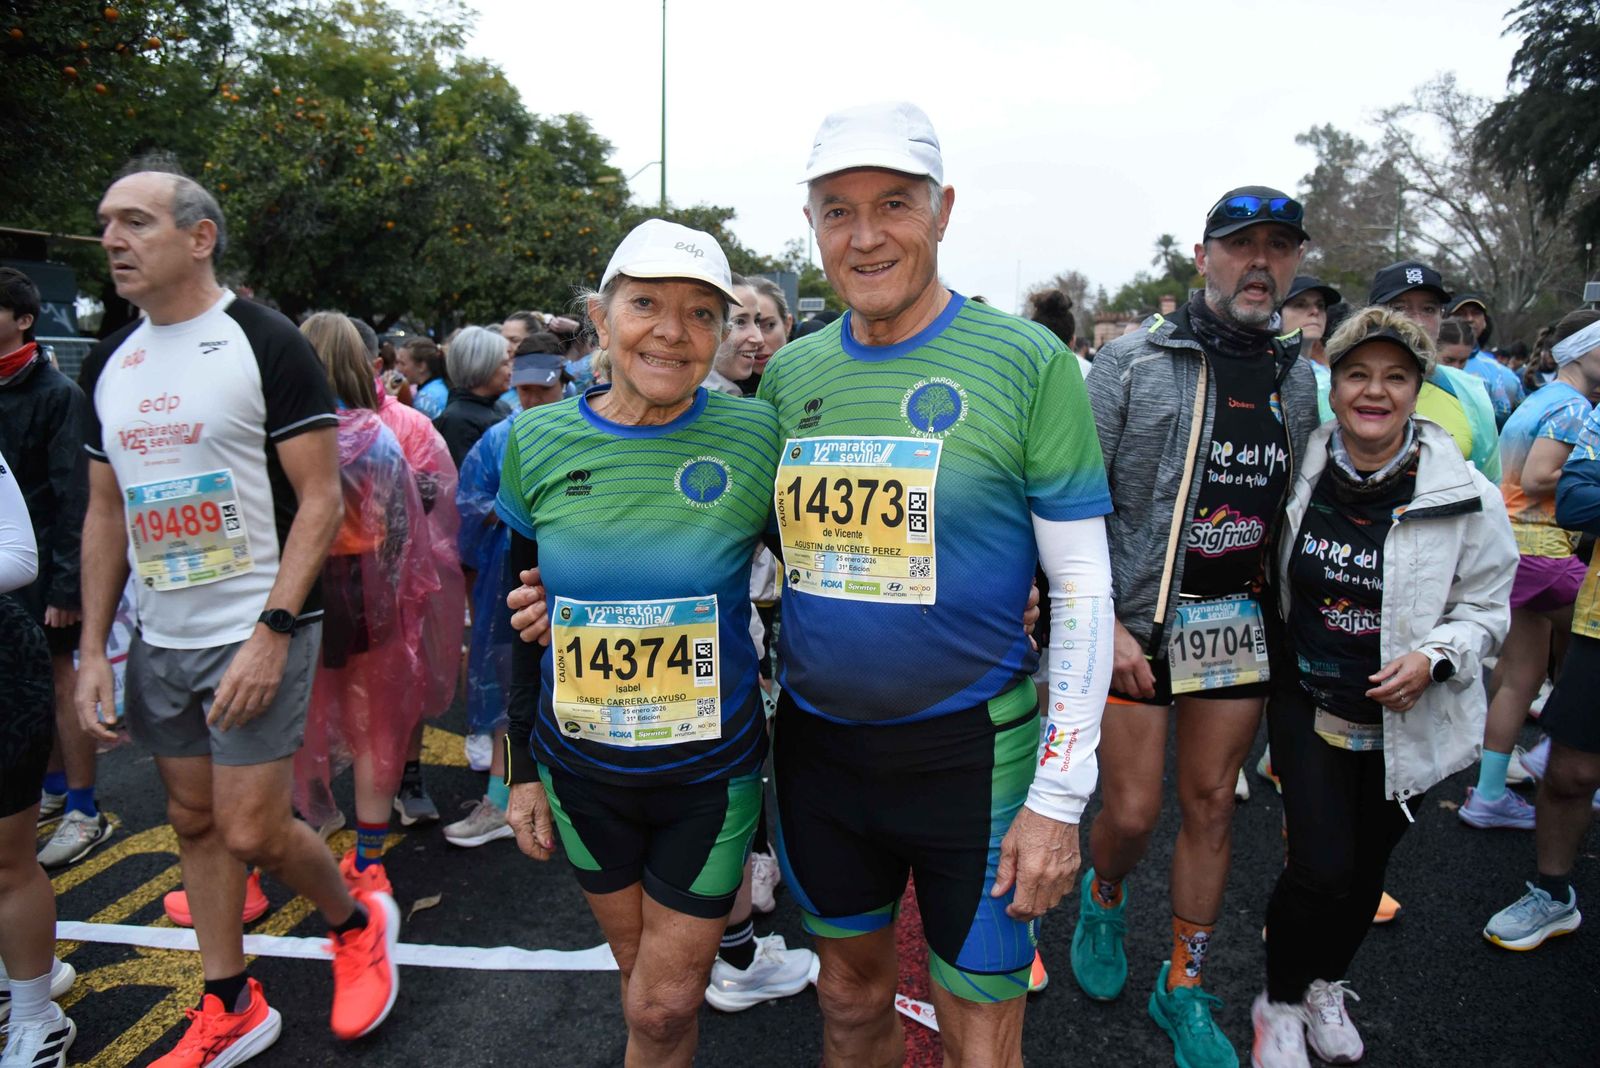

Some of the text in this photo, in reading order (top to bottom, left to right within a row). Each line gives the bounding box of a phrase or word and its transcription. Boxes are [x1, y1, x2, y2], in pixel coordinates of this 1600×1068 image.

[674, 241, 704, 258] edp
[930, 377, 961, 390] PARQUE
[139, 392, 181, 414] edp
[840, 450, 881, 462] sevilla
[1236, 443, 1259, 466] del
[1235, 473, 1243, 485] el
[787, 476, 904, 528] 14373
[134, 501, 222, 543] 19489
[822, 528, 863, 539] de Vicente
[1187, 520, 1263, 554] Sigfrido
[794, 540, 823, 550] AGUSTIN
[836, 544, 870, 554] VICENTE
[872, 546, 901, 556] PEREZ
[1353, 548, 1377, 570] del
[821, 579, 843, 589] HOKA
[848, 583, 876, 592] Sprinter
[602, 605, 662, 616] maratón
[617, 613, 662, 625] sevilla
[1173, 623, 1254, 661] 19704
[566, 634, 692, 681] 14374
[557, 656, 566, 683] CAJÓN
[616, 683, 641, 693] Isabel
[577, 693, 687, 706] ISABEL CARRERA CAYUSO
[609, 730, 632, 738] HOKA
[638, 730, 669, 738] Sprinter
